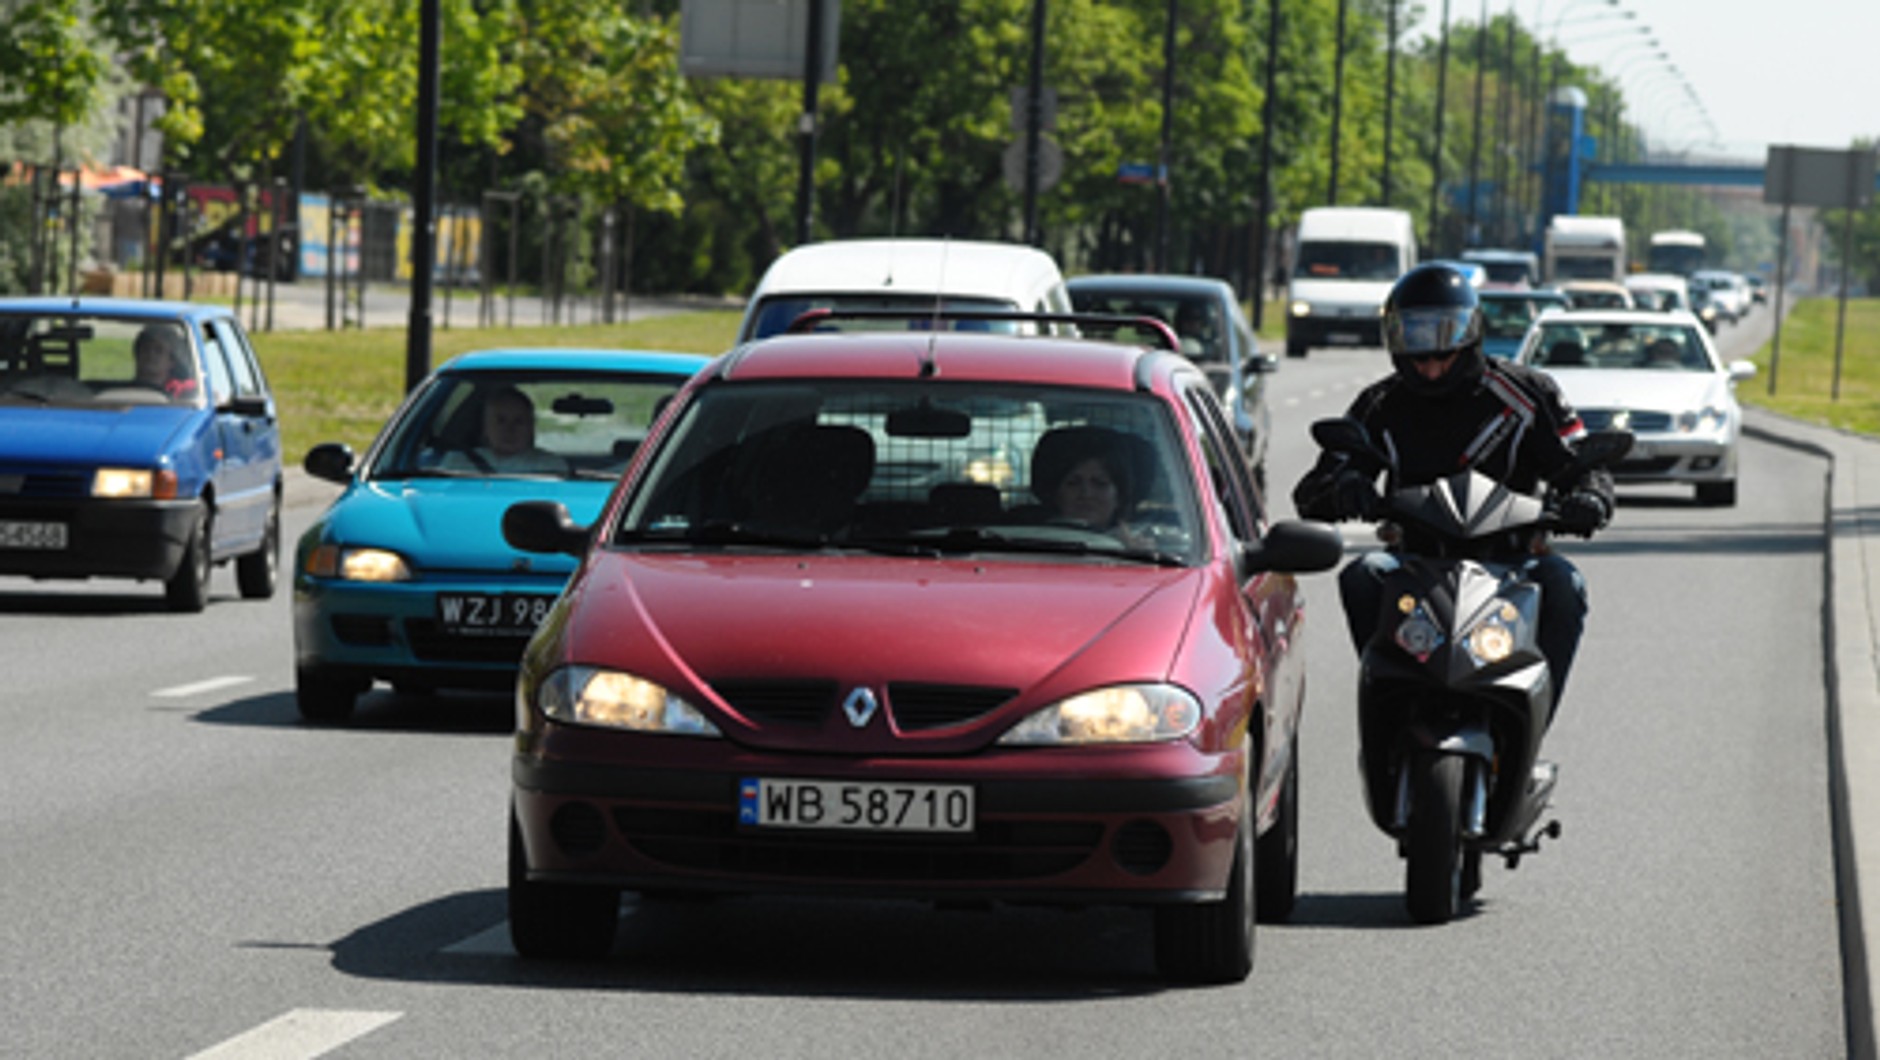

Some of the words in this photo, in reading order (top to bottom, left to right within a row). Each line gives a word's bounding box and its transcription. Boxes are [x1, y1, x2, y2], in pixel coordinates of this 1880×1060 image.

[441, 597, 502, 625] WZJ
[766, 785, 824, 824] WB
[840, 787, 968, 828] 58710
